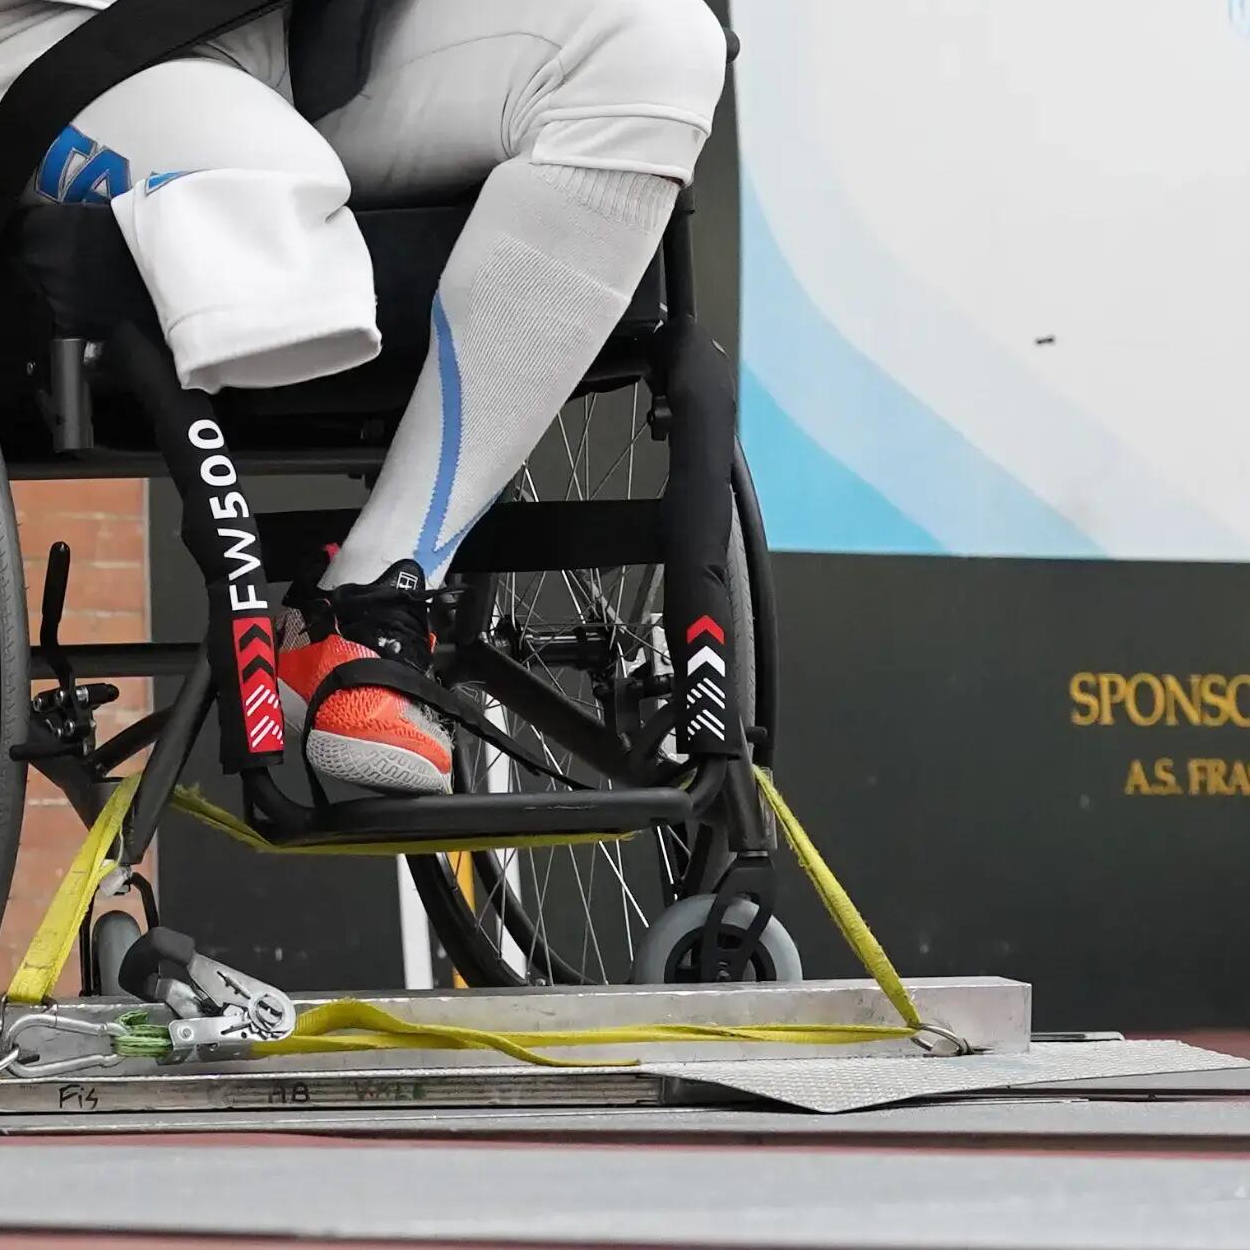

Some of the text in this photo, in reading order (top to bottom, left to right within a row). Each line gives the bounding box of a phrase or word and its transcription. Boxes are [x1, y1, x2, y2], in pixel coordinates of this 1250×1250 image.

[187, 418, 269, 612] FW500
[1069, 671, 1250, 728] SPONSO
[1187, 758, 1250, 796] FRA
